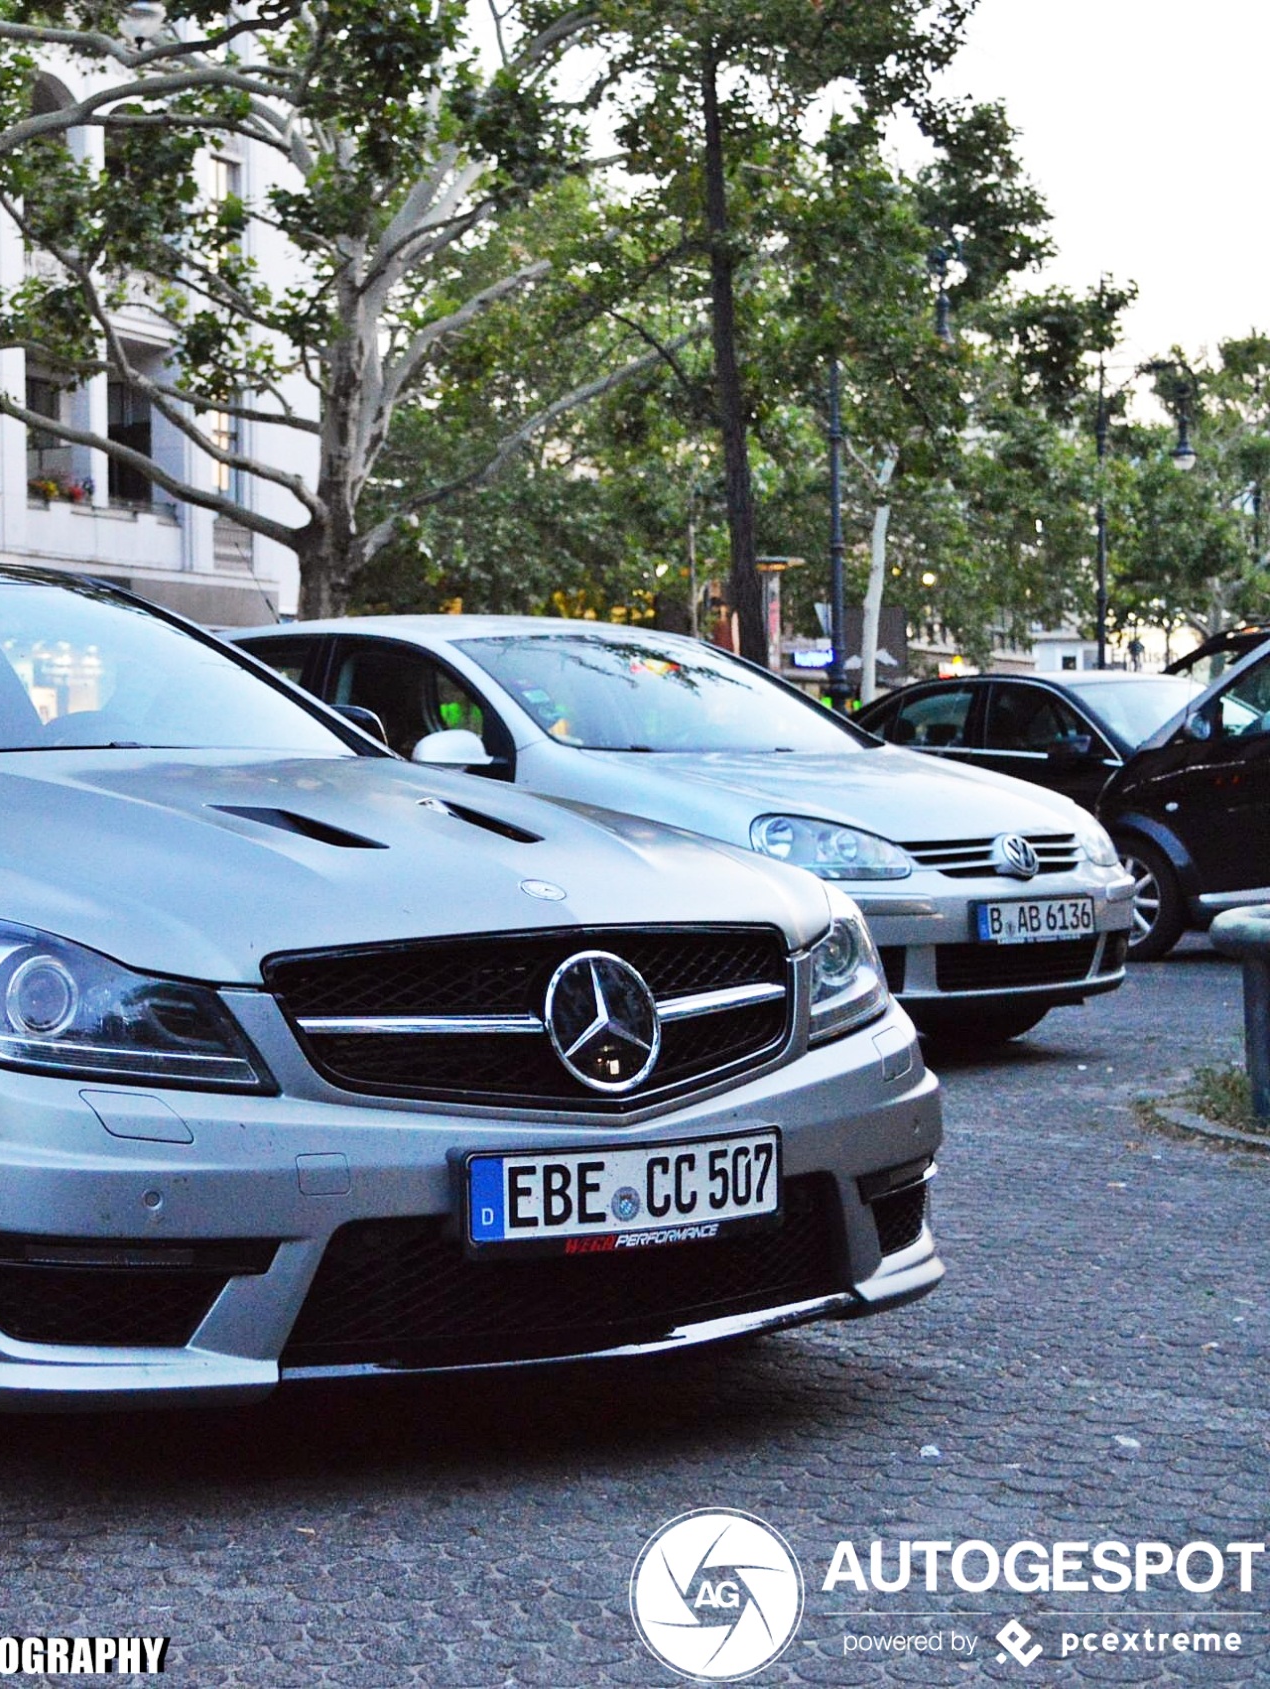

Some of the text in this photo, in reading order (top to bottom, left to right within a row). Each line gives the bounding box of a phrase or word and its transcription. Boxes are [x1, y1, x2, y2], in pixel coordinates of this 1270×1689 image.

[989, 902, 1091, 935] B AB 6136
[482, 1142, 774, 1229] D EBE CC 507
[615, 1223, 720, 1248] PERFORMANCE
